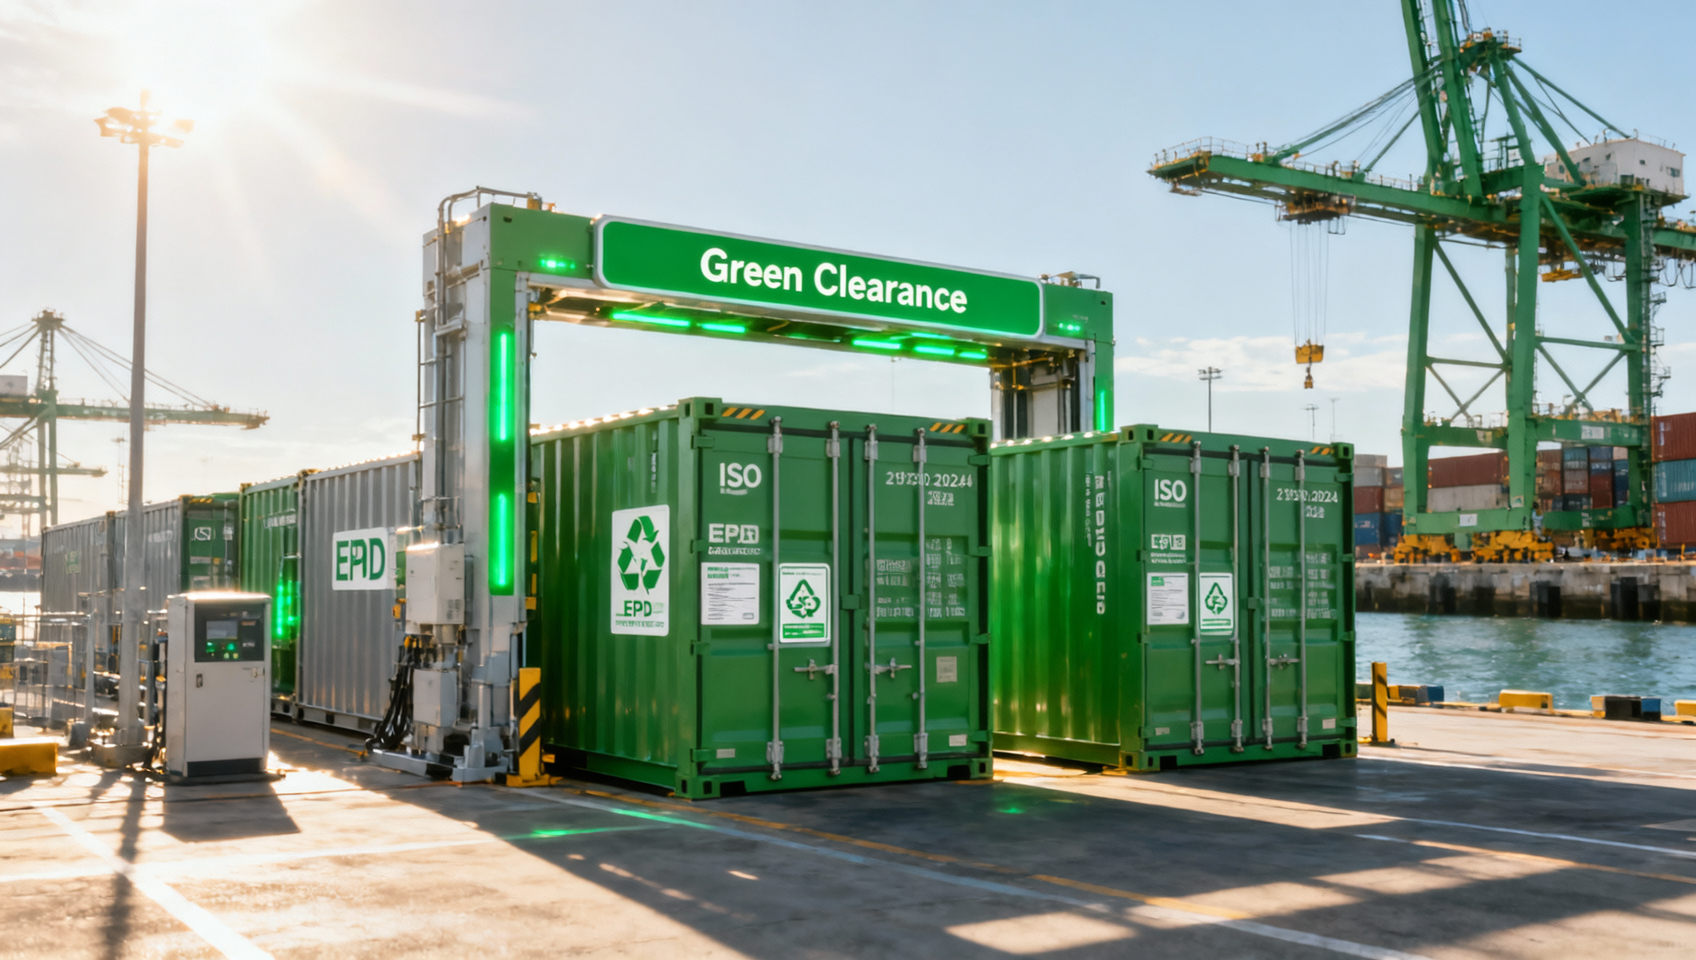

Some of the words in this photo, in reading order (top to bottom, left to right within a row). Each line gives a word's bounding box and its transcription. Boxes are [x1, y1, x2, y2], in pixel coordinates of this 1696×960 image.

[700, 248, 802, 292] Green
[814, 262, 967, 313] Clearance
[719, 462, 762, 488] ISO
[1154, 478, 1187, 502] ISO
[623, 599, 653, 617] EPD
